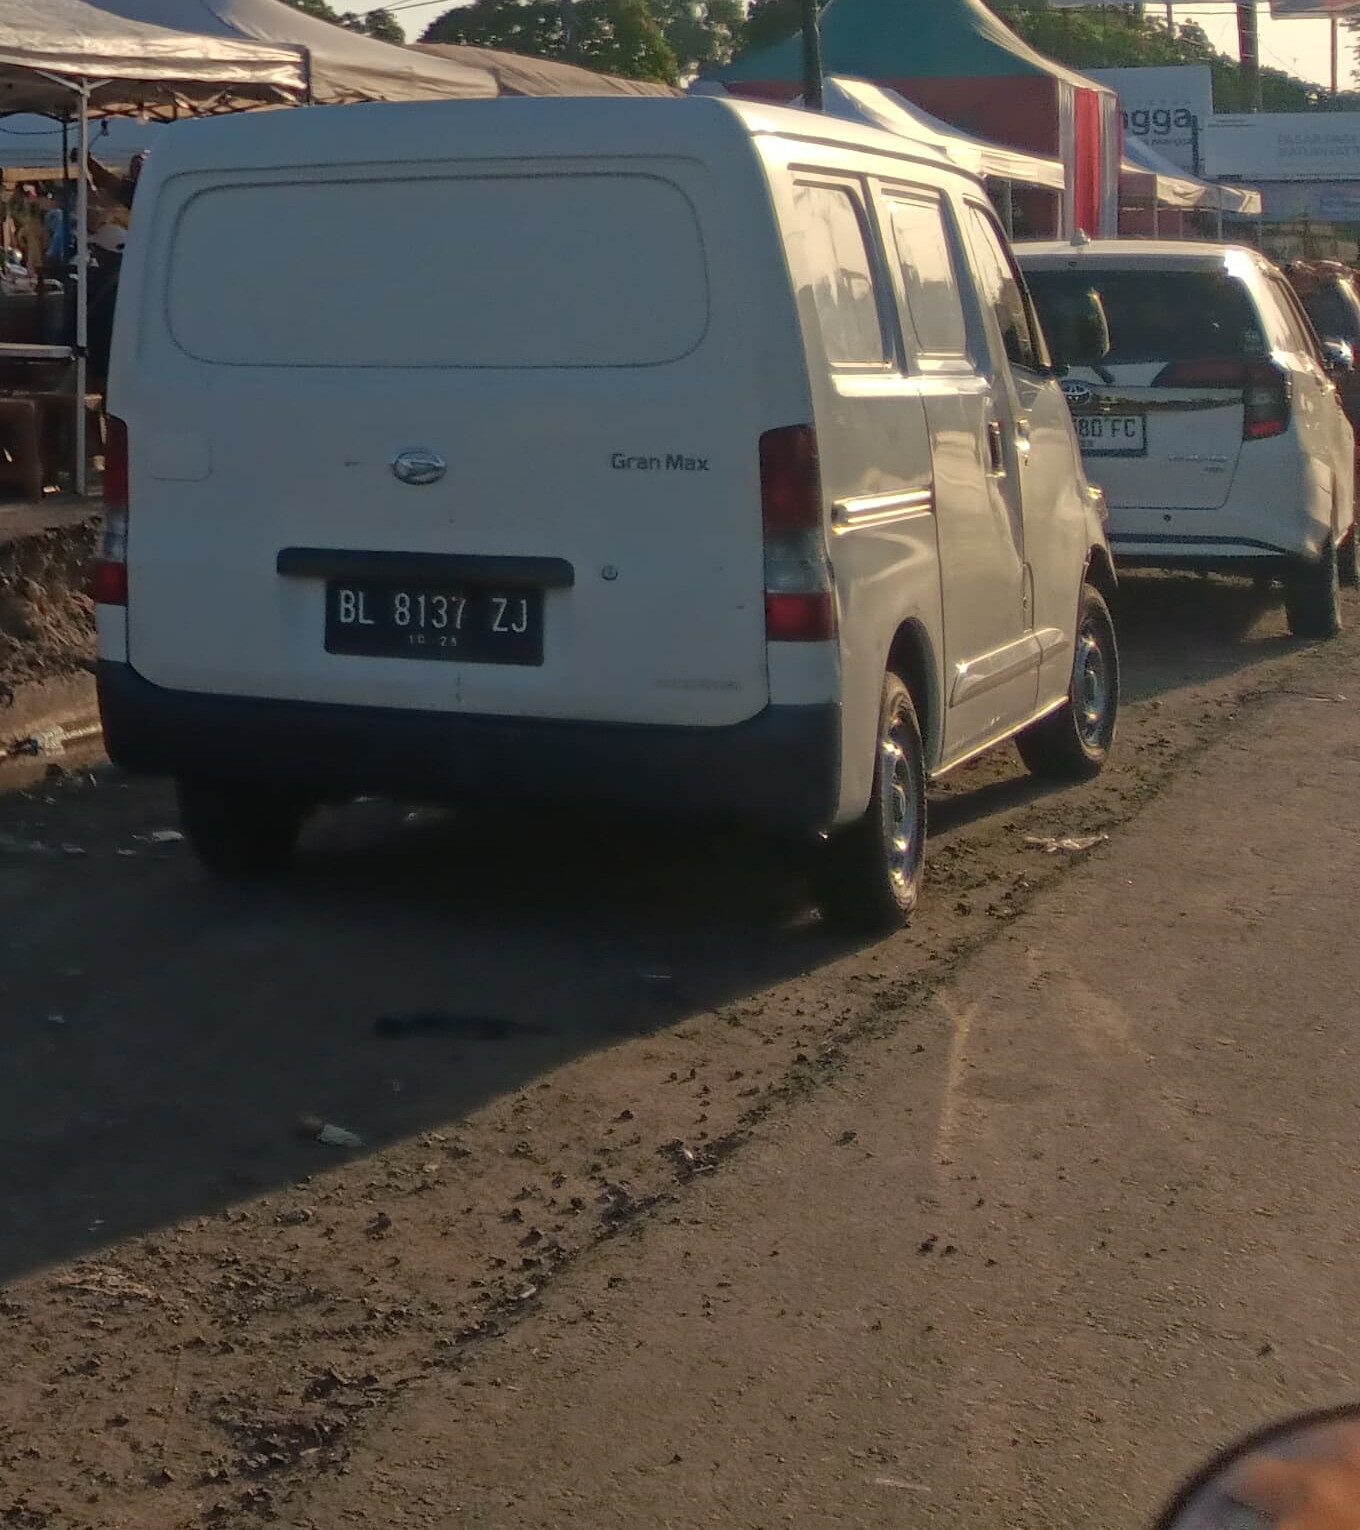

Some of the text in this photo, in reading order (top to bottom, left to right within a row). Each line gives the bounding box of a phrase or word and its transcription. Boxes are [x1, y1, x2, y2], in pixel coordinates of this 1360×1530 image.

[1111, 419, 1136, 438] FC
[612, 453, 711, 471] Gran Max
[339, 589, 528, 633] BL 8137 ZJ
